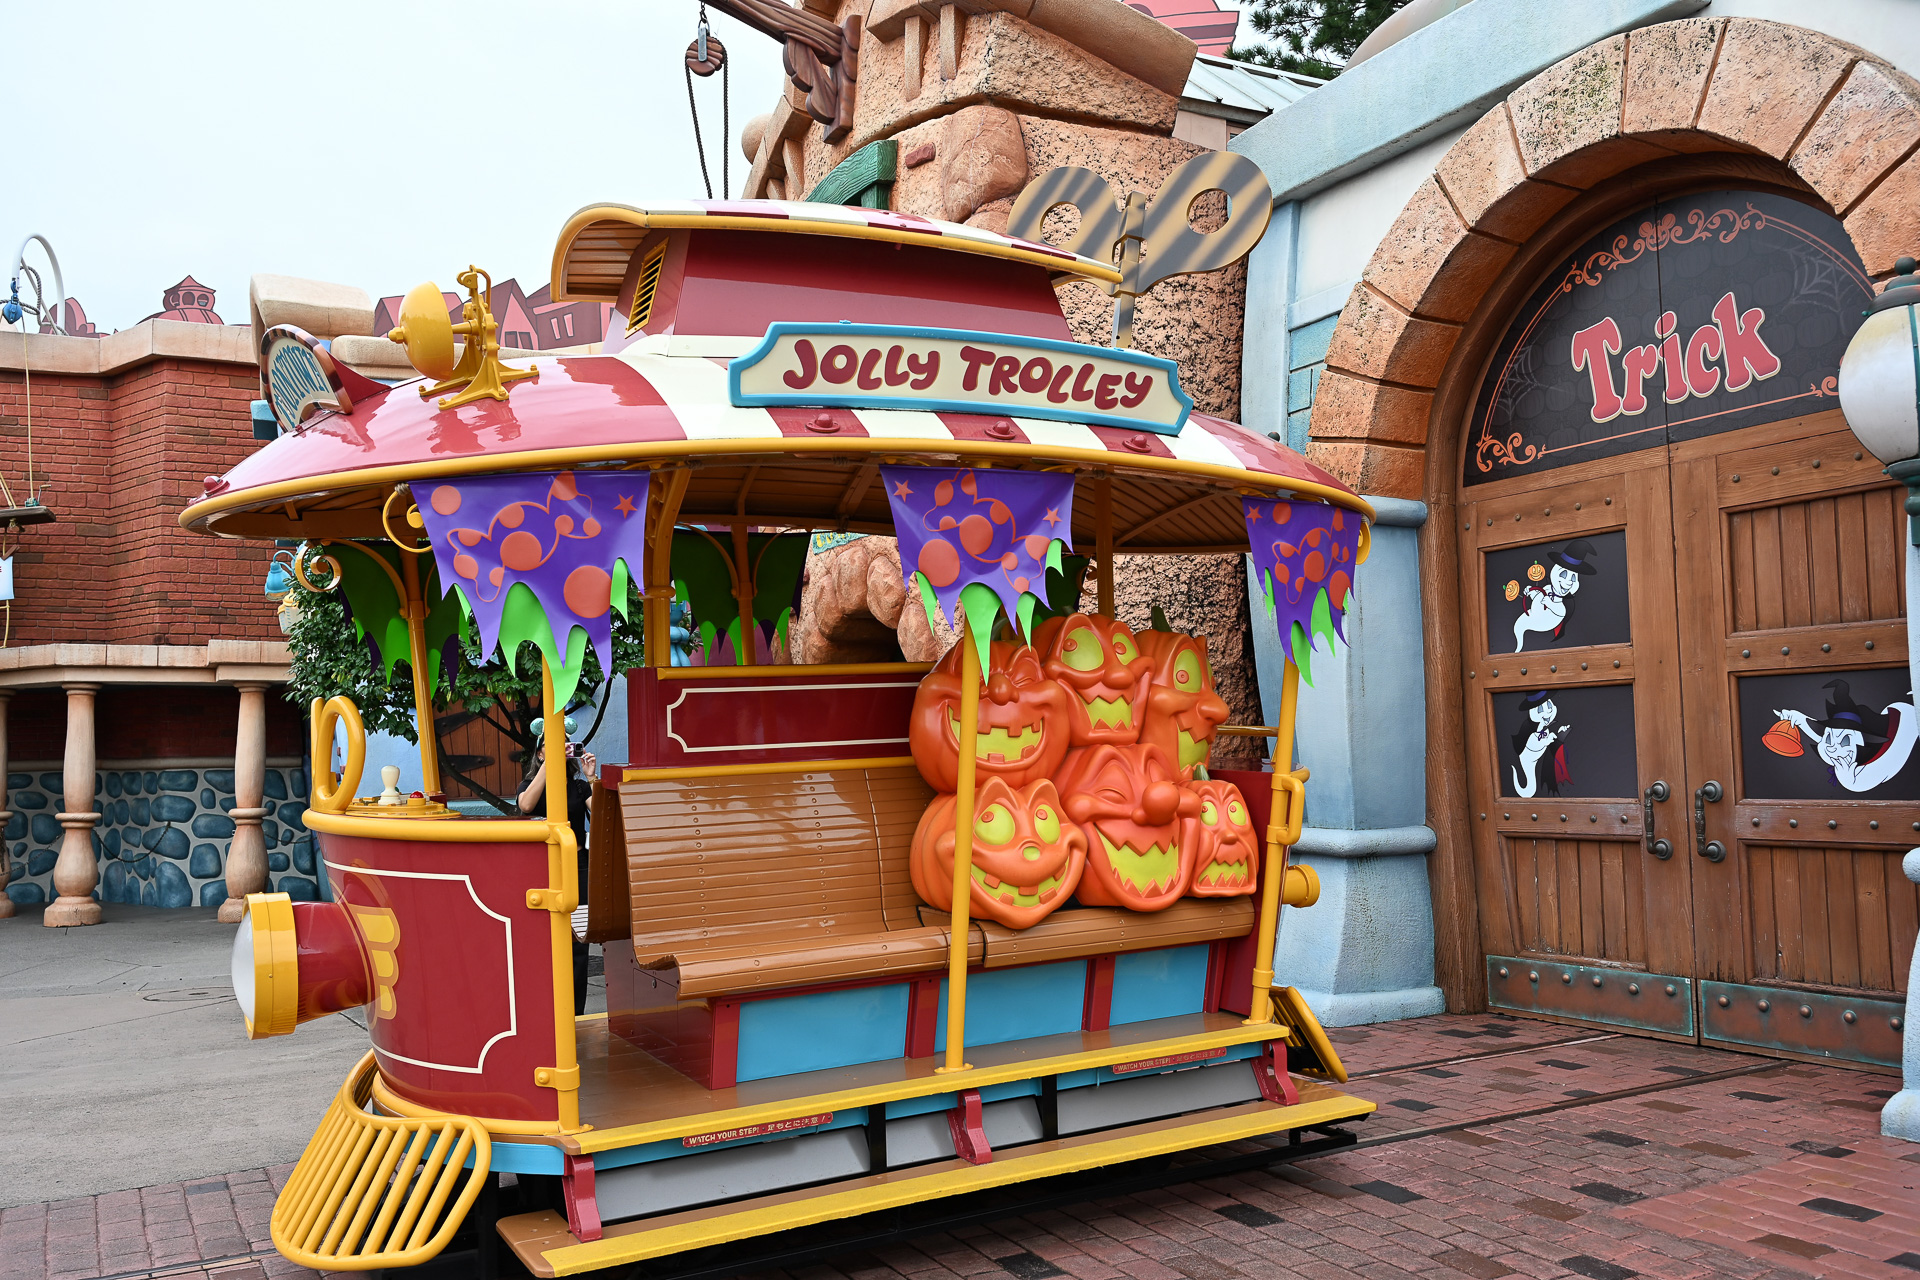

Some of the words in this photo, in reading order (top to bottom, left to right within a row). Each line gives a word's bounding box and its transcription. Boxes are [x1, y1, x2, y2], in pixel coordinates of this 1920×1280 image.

[783, 339, 940, 391] JOLLY
[959, 345, 1154, 410] TROLLEY
[1571, 291, 1781, 423] Trick
[717, 1130, 737, 1139] YOUR
